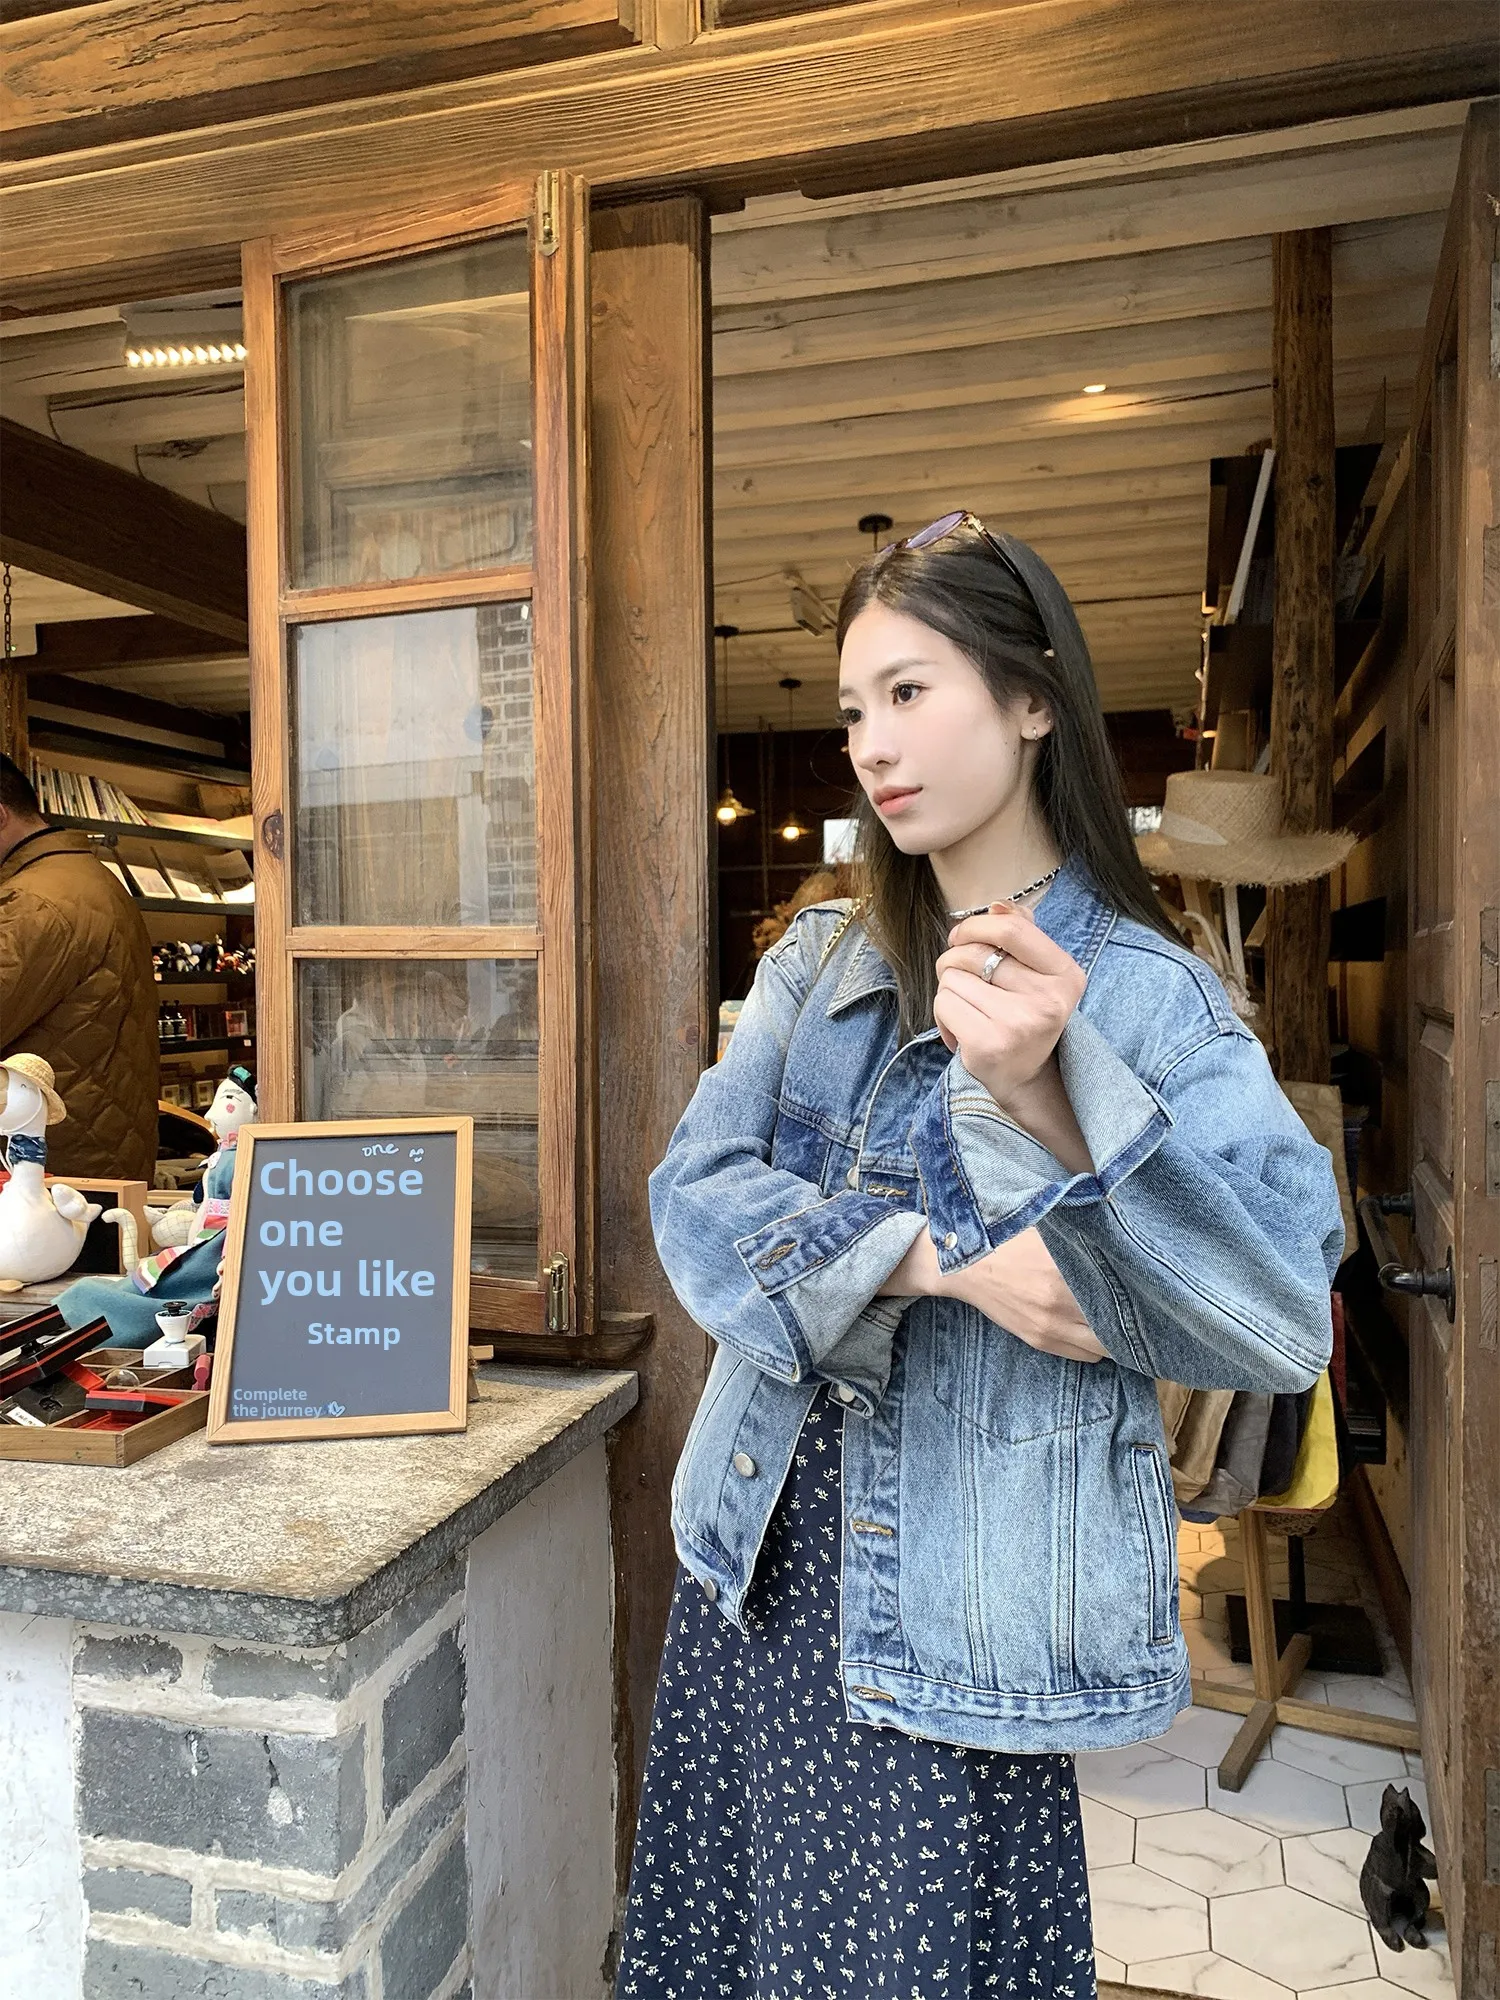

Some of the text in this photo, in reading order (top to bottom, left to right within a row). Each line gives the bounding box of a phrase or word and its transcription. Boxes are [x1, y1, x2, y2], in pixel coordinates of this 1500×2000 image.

[361, 1143, 399, 1157] one
[260, 1159, 424, 1196] Choose
[259, 1220, 344, 1247] one
[258, 1259, 435, 1306] you like
[307, 1322, 401, 1350] Stamp
[233, 1388, 308, 1403] Complete
[232, 1403, 322, 1419] the journey
